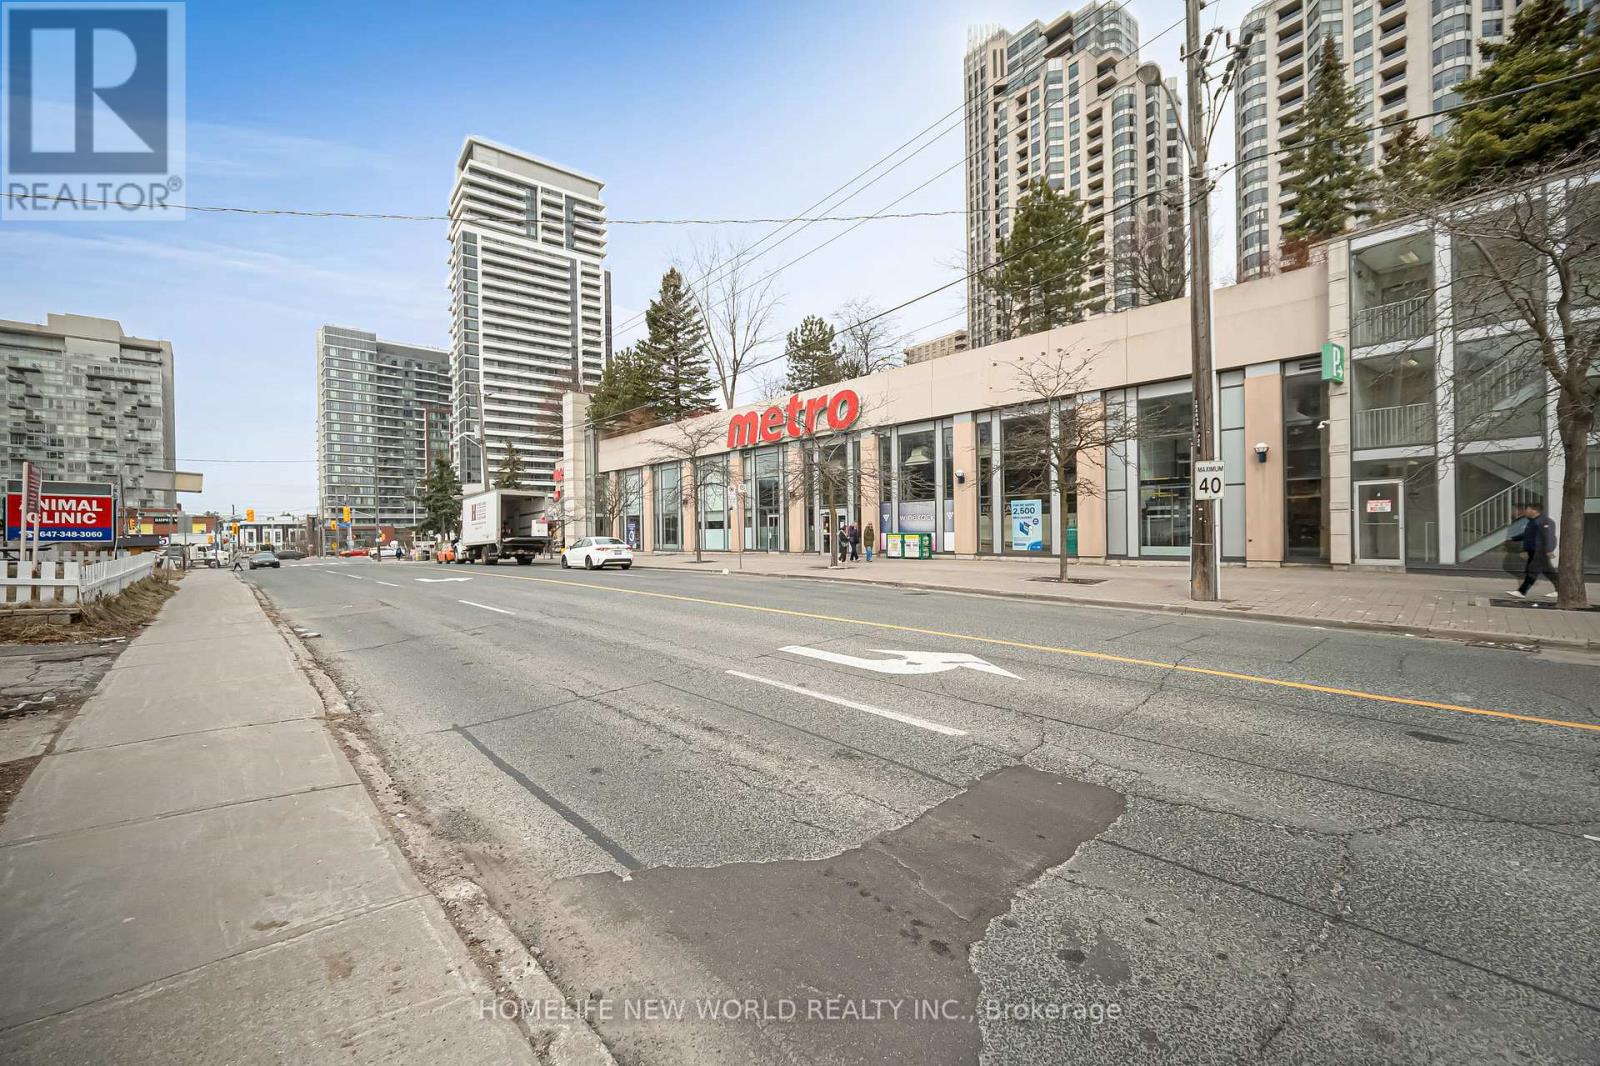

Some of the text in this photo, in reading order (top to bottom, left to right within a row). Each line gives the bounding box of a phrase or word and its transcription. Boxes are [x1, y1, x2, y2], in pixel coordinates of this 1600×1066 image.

[726, 389, 862, 449] metro
[1197, 465, 1224, 473] MAXIMUM
[1199, 477, 1221, 493] 40
[19, 498, 103, 512] NIMAL
[39, 530, 103, 539] 647-348-3060
